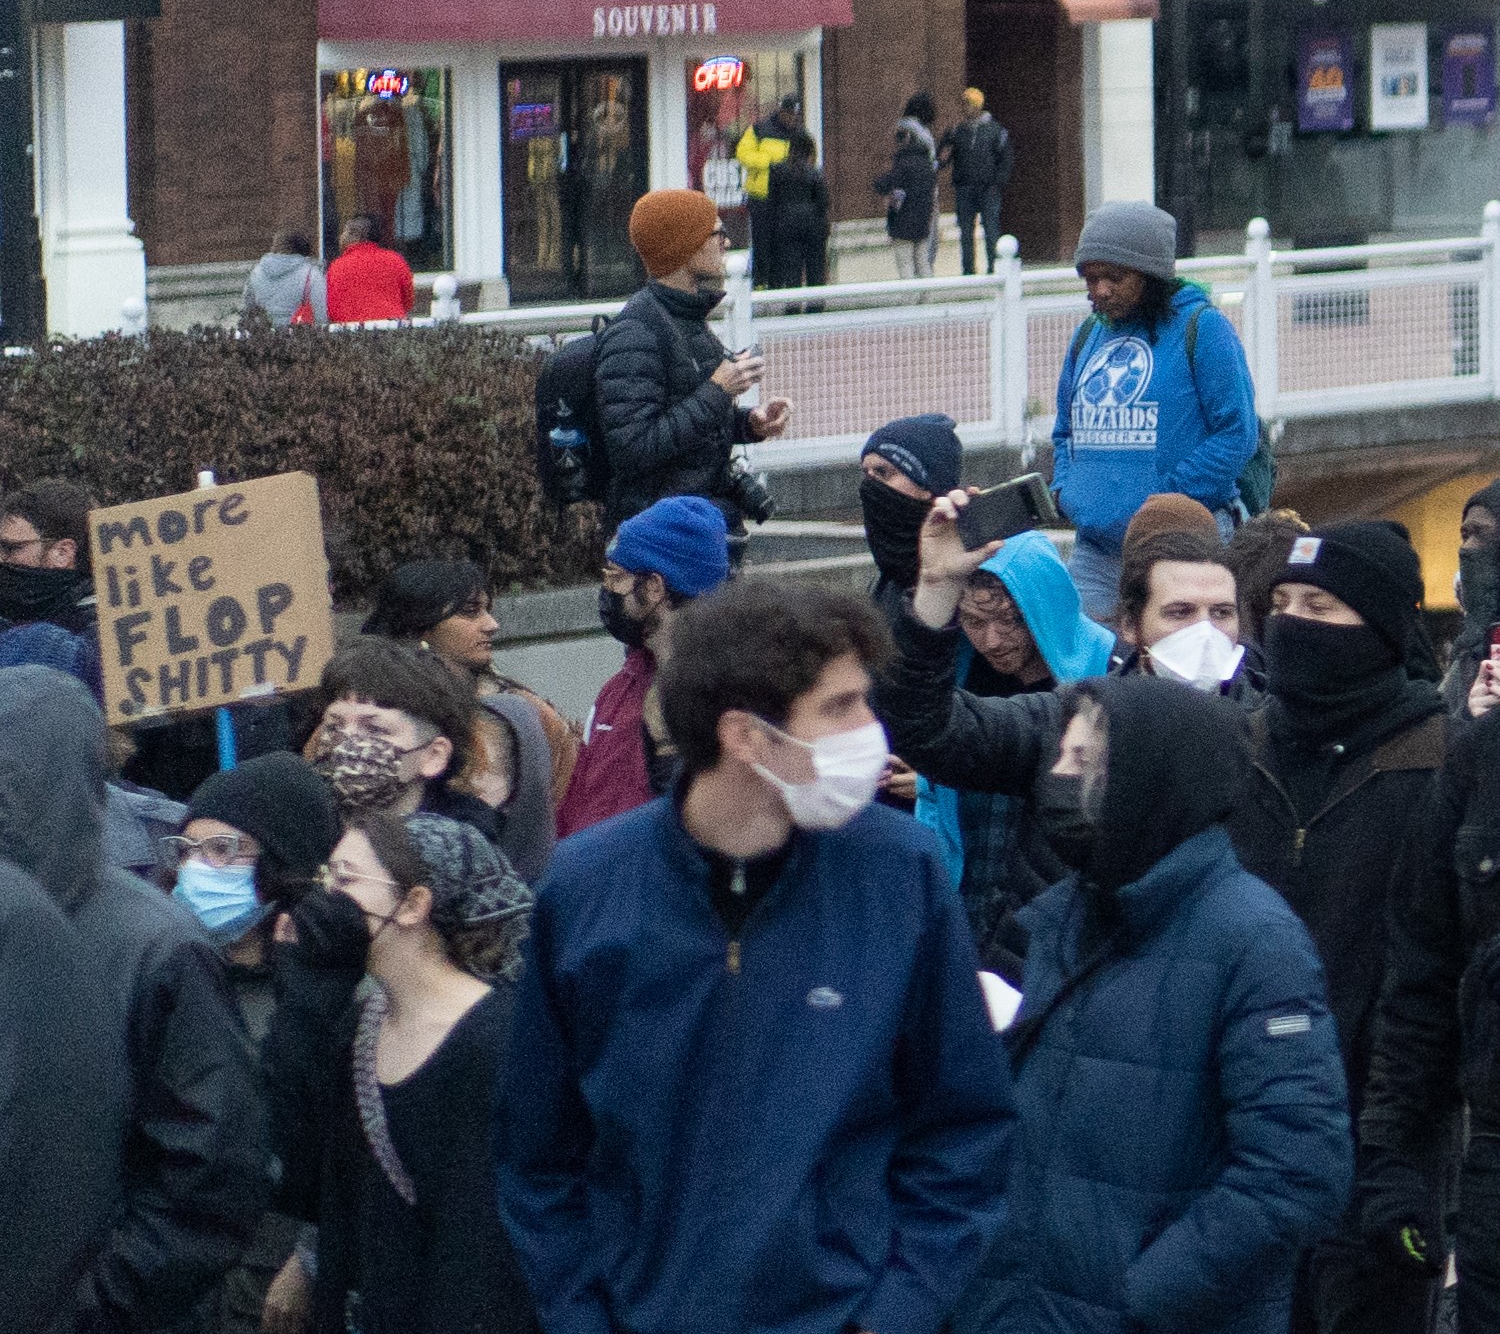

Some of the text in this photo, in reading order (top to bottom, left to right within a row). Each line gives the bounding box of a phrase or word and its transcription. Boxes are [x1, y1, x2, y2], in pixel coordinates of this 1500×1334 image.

[592, 3, 717, 38] SOUVENIR
[694, 62, 744, 92] OPEN
[99, 492, 250, 554] more
[105, 554, 217, 608] like
[114, 582, 295, 667] FLOP
[118, 634, 308, 717] SHITTY
